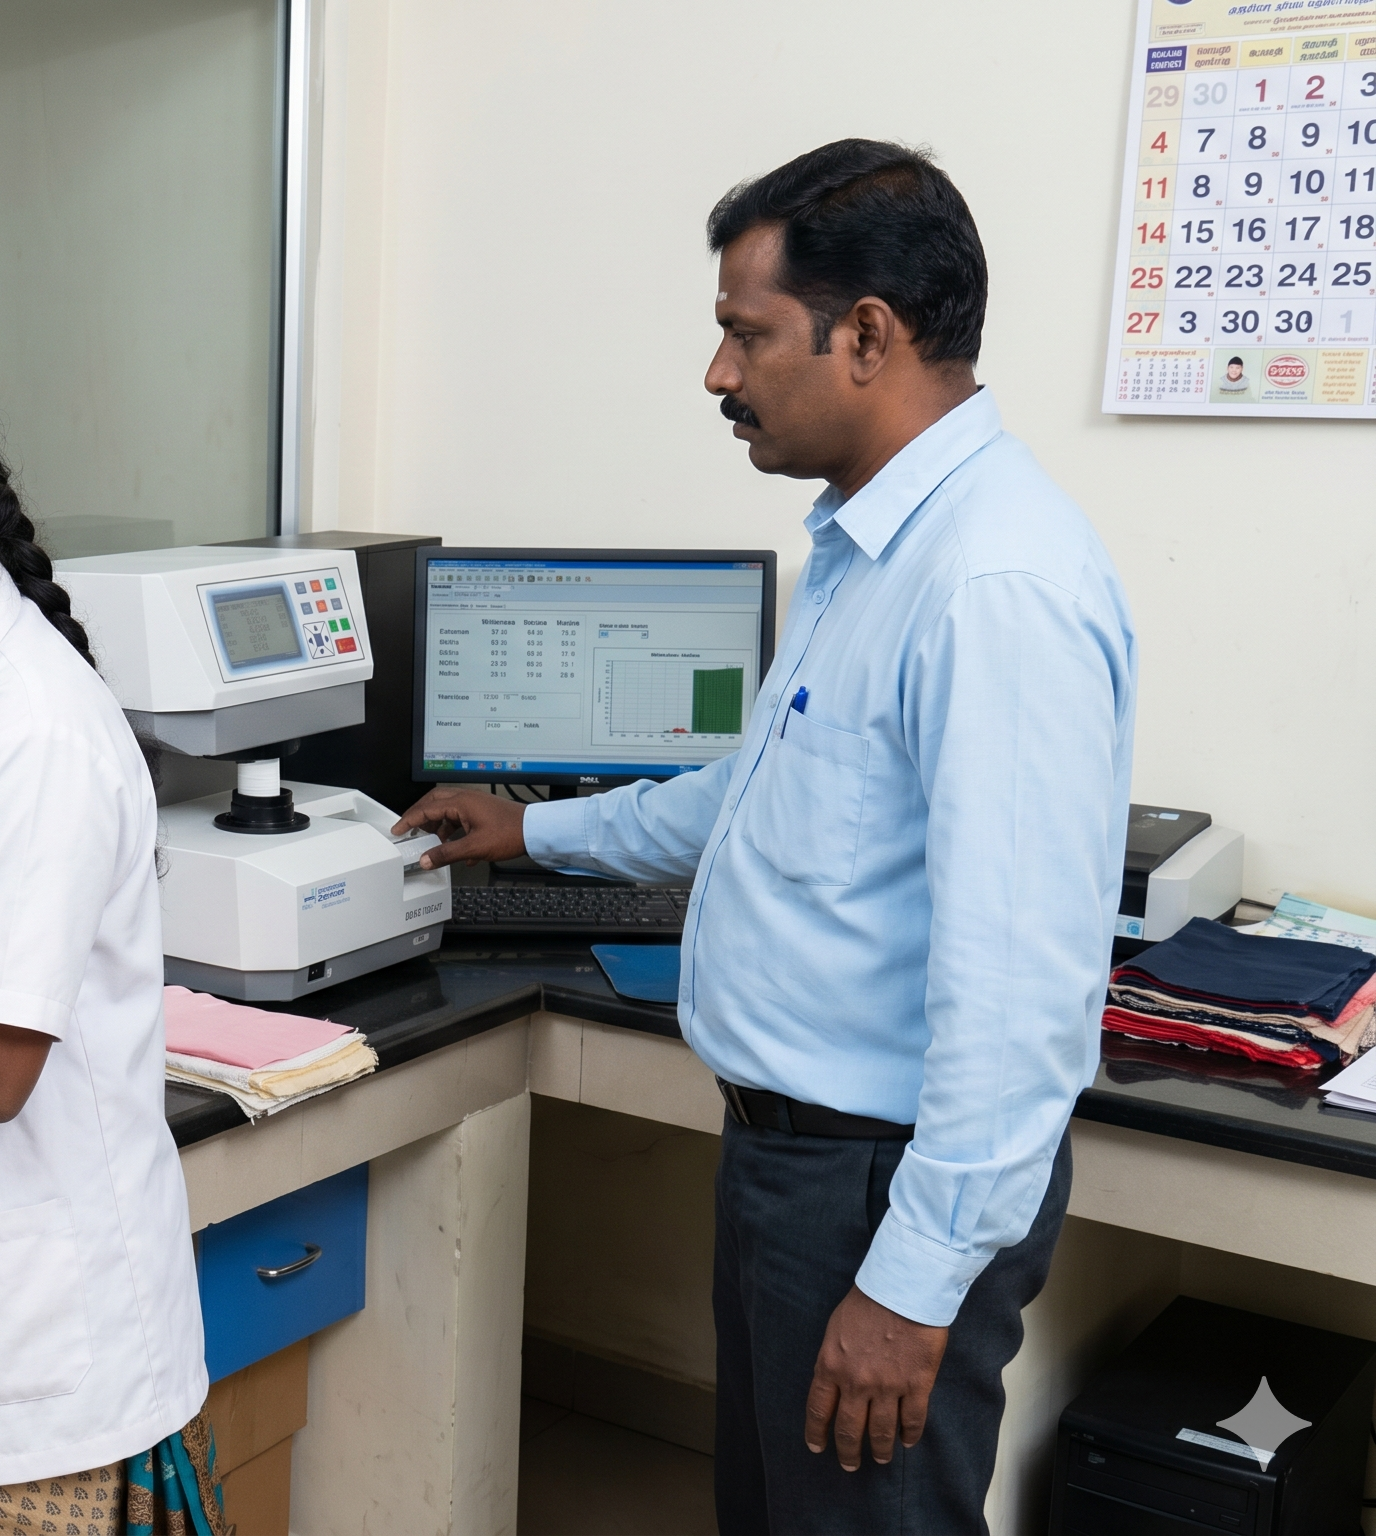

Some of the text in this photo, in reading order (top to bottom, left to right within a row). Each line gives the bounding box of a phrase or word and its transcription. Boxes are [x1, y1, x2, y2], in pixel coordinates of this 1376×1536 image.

[1147, 85, 1179, 108] 29
[1193, 82, 1227, 105] 30
[1256, 79, 1266, 102] 1
[1305, 76, 1324, 99] 2
[1151, 132, 1167, 153] 4
[1198, 129, 1215, 152] 7
[1248, 126, 1266, 149] 8
[1302, 123, 1319, 147] 9
[1143, 168, 1374, 198] 11 8 9 10 11
[1138, 215, 1374, 244] 14 15 16 17 18
[1131, 262, 1371, 289] 25 22 23 24 25
[1127, 310, 1352, 333] 27 3 30 30 1
